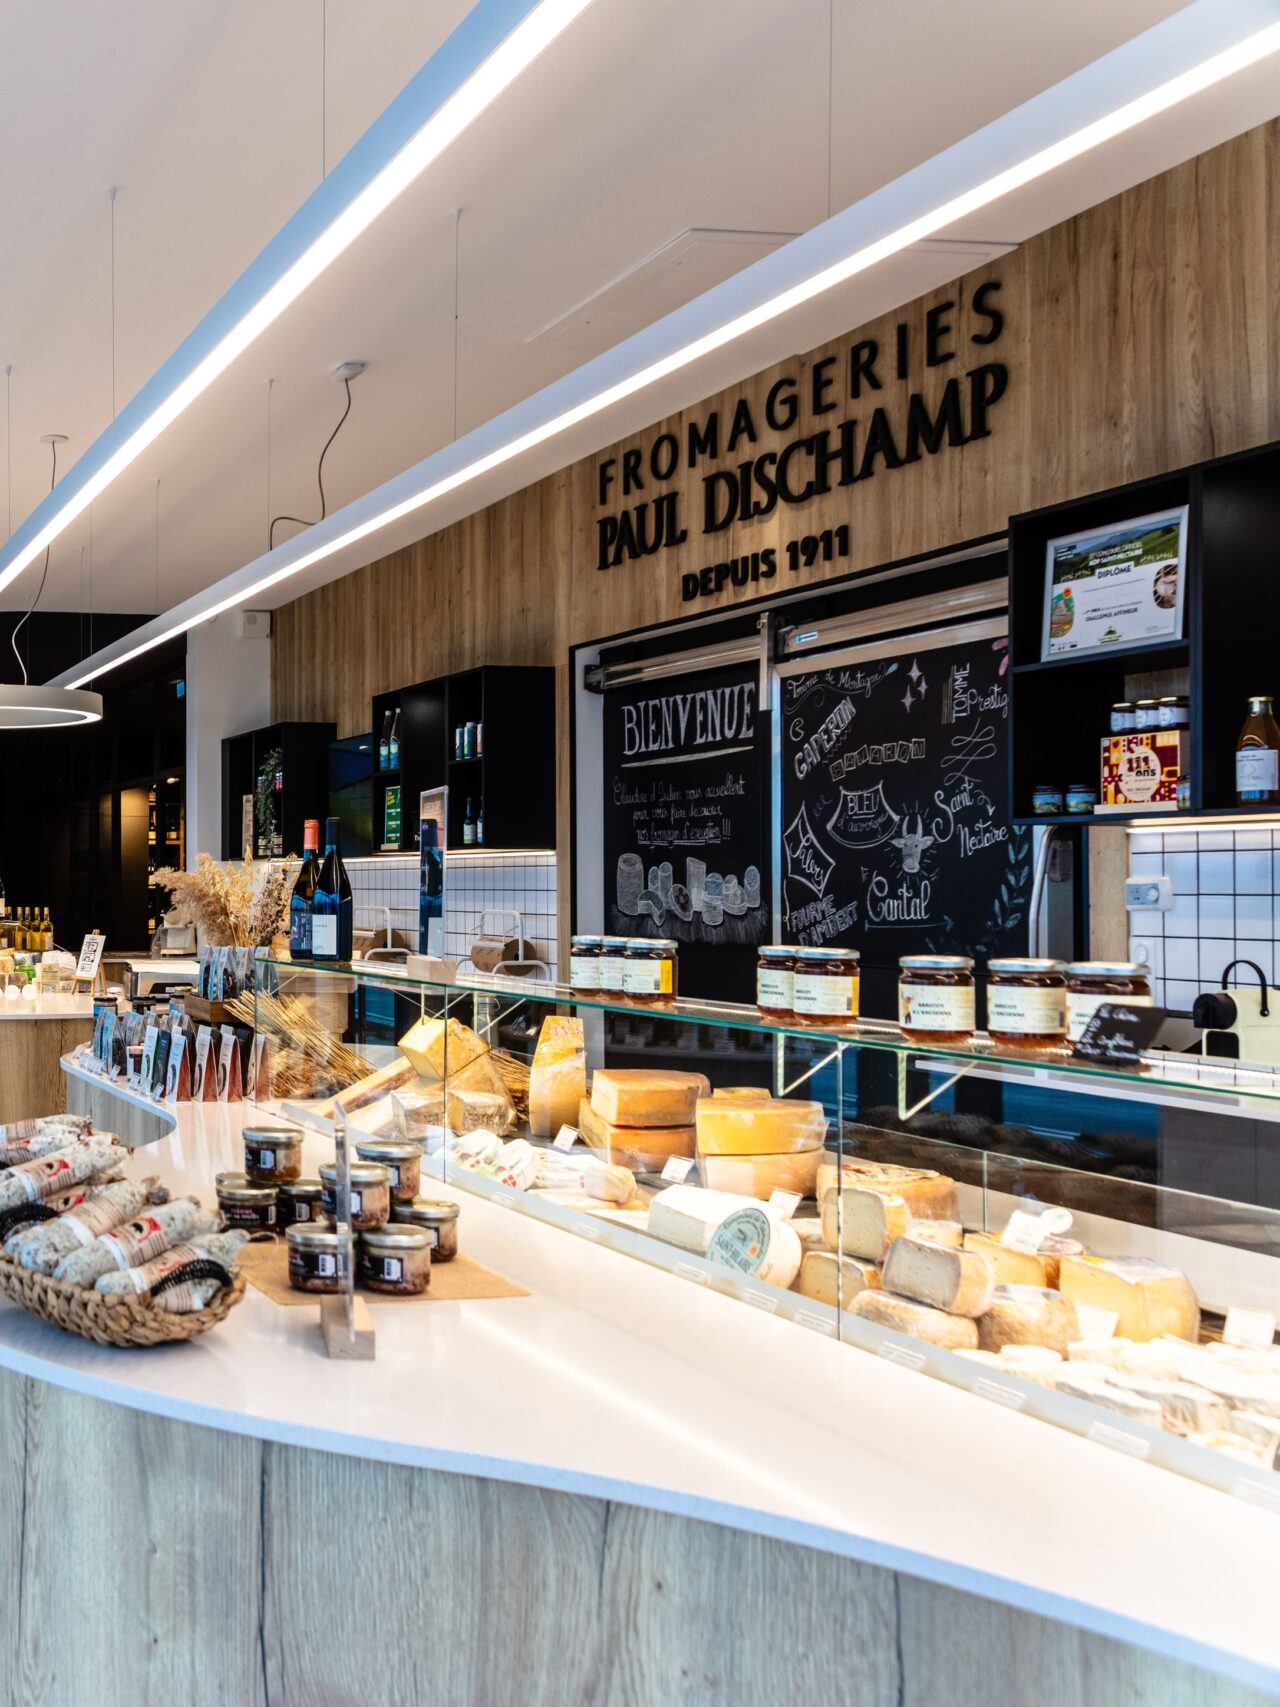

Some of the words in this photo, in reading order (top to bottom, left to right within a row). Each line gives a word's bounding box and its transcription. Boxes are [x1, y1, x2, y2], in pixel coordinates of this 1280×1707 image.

[598, 281, 1003, 505] FROMAGERIES
[596, 490, 687, 571] PAUL
[702, 362, 1009, 535] DISCHAMP
[682, 547, 776, 601] DEPUIS
[786, 524, 850, 571] 1911
[621, 681, 756, 756] BIENVENUE
[952, 662, 970, 723] TOMME
[967, 683, 1009, 719] Prestig
[794, 696, 856, 780] GAPERON
[847, 793, 880, 815] BLEU
[932, 775, 974, 843] Saint
[957, 819, 1009, 858] Nectaire
[791, 894, 837, 932] FOURME
[867, 870, 931, 922] Cantal
